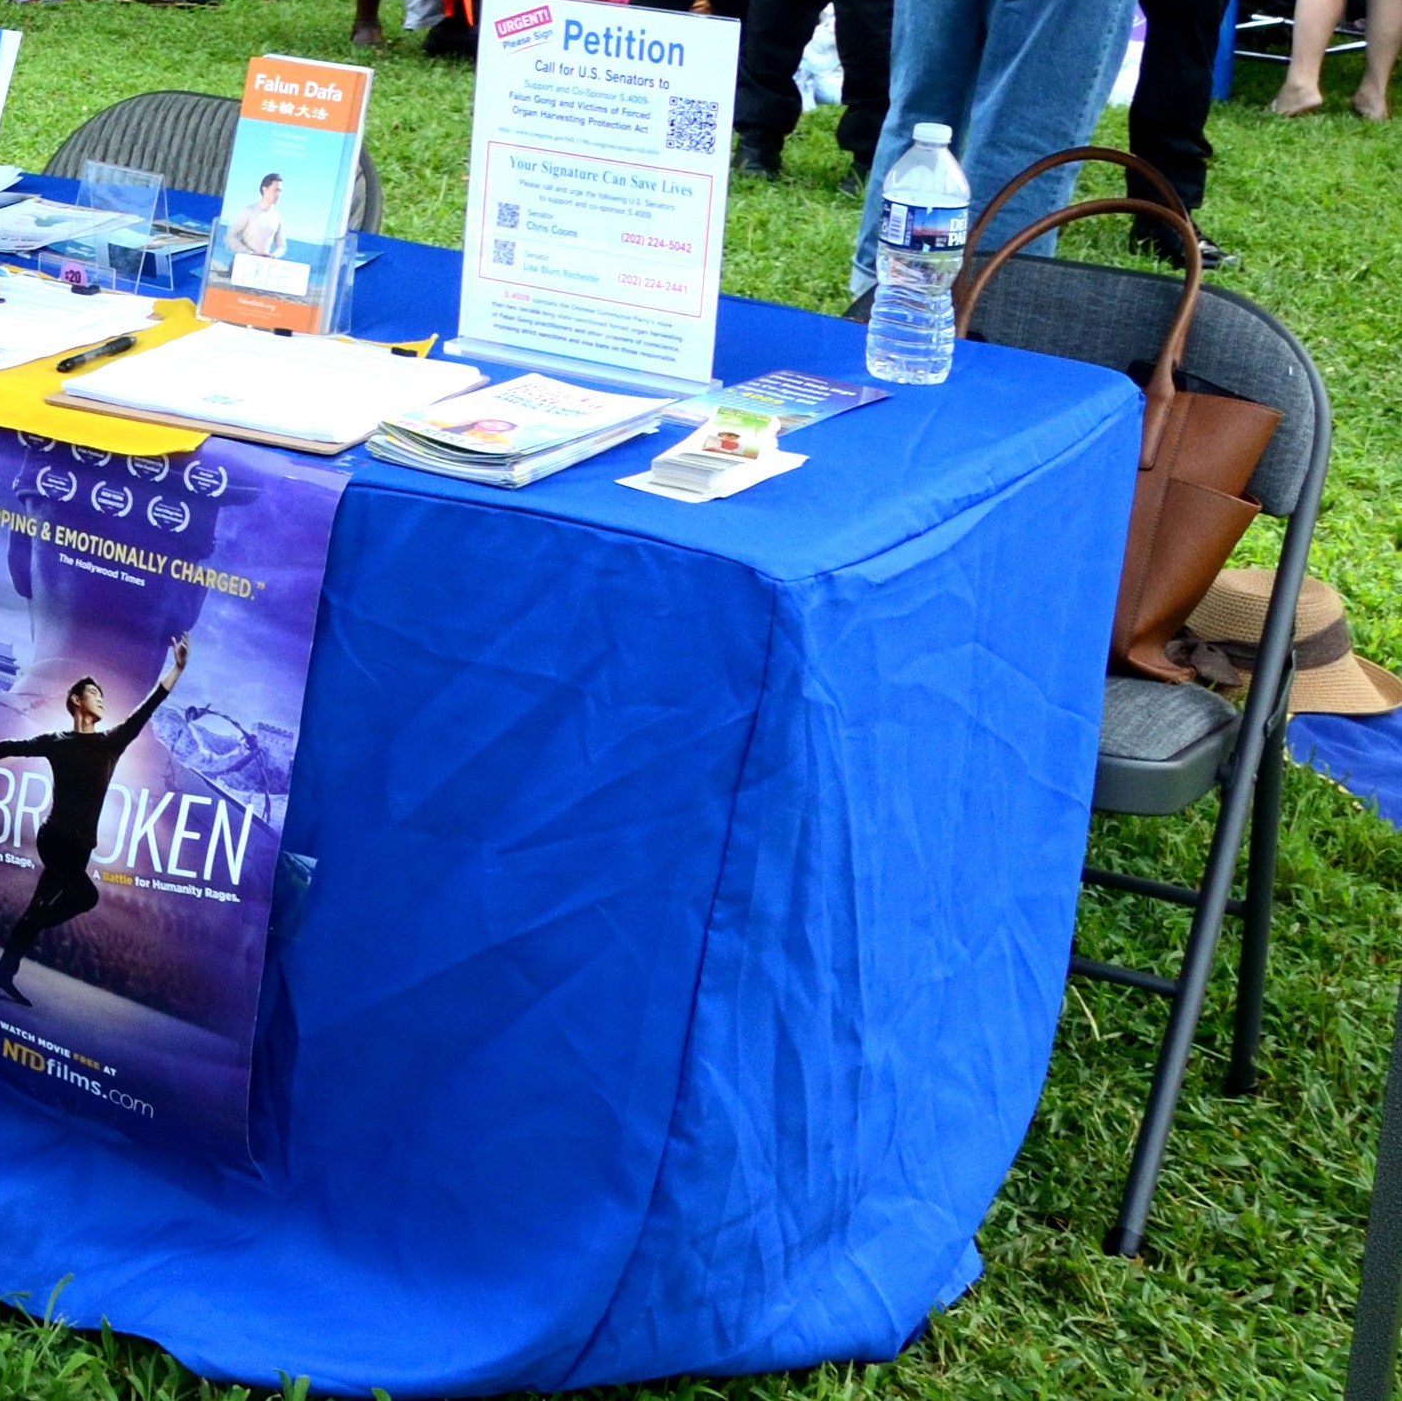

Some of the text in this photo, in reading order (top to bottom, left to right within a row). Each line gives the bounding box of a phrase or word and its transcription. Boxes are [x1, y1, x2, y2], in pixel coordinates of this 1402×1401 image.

[497, 9, 550, 37] URGENT!
[502, 29, 554, 49] Please Sign
[563, 19, 685, 67] Petition
[254, 73, 343, 103] Falun Dafa
[535, 59, 670, 90] Call for U.S. Senators to
[260, 99, 329, 121] 法輪大法
[512, 105, 538, 121] Organ
[634, 122, 649, 134] Act
[533, 94, 556, 108] Gong
[622, 106, 651, 120] Forced
[509, 155, 693, 197] Your Signature Can Save Lives
[621, 232, 692, 254] (202) 224-5042
[64, 269, 82, 284] $20
[618, 273, 641, 287] (202)
[41, 521, 52, 540] &
[55, 524, 168, 575] EMOTIONALLY
[58, 553, 146, 587] The Hollywood Times
[5, 852, 35, 870] Stage,
[92, 868, 101, 882] A
[102, 871, 133, 888] Battle
[135, 876, 151, 889] for
[152, 878, 203, 899] Humanity
[205, 886, 241, 903] Rages.
[0, 1020, 118, 1077] WATCH MOVIE FREE AT
[1, 1036, 155, 1119] NTDfilms.com
